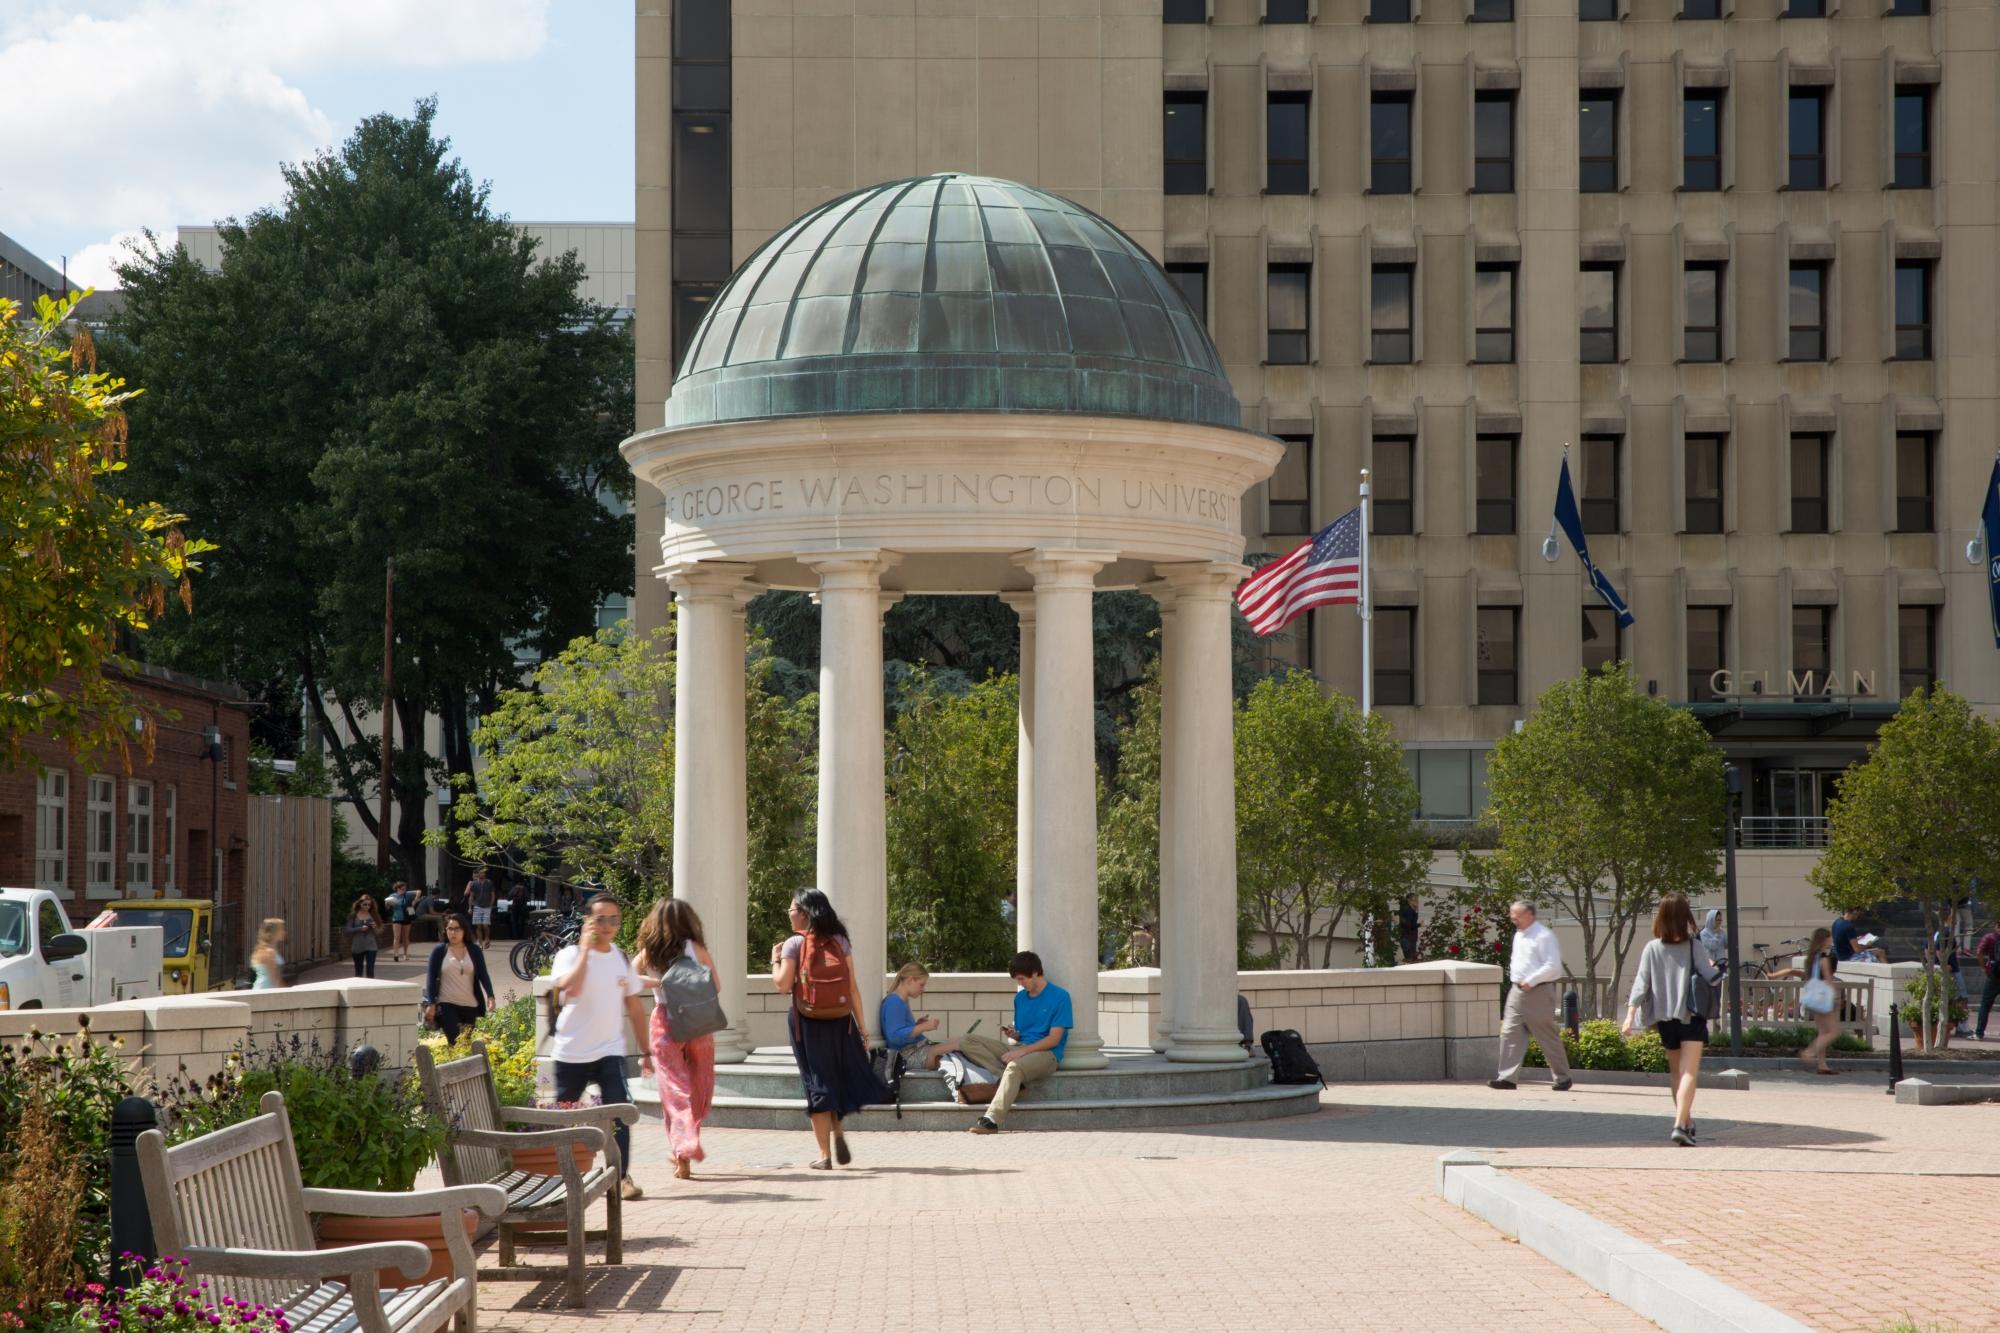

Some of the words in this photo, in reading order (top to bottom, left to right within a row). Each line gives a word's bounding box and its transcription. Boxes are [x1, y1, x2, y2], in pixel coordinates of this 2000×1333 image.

[682, 480, 784, 521] GEORGE
[799, 473, 1101, 507] WASHINGTON
[1710, 669, 1876, 696] GELMAN
